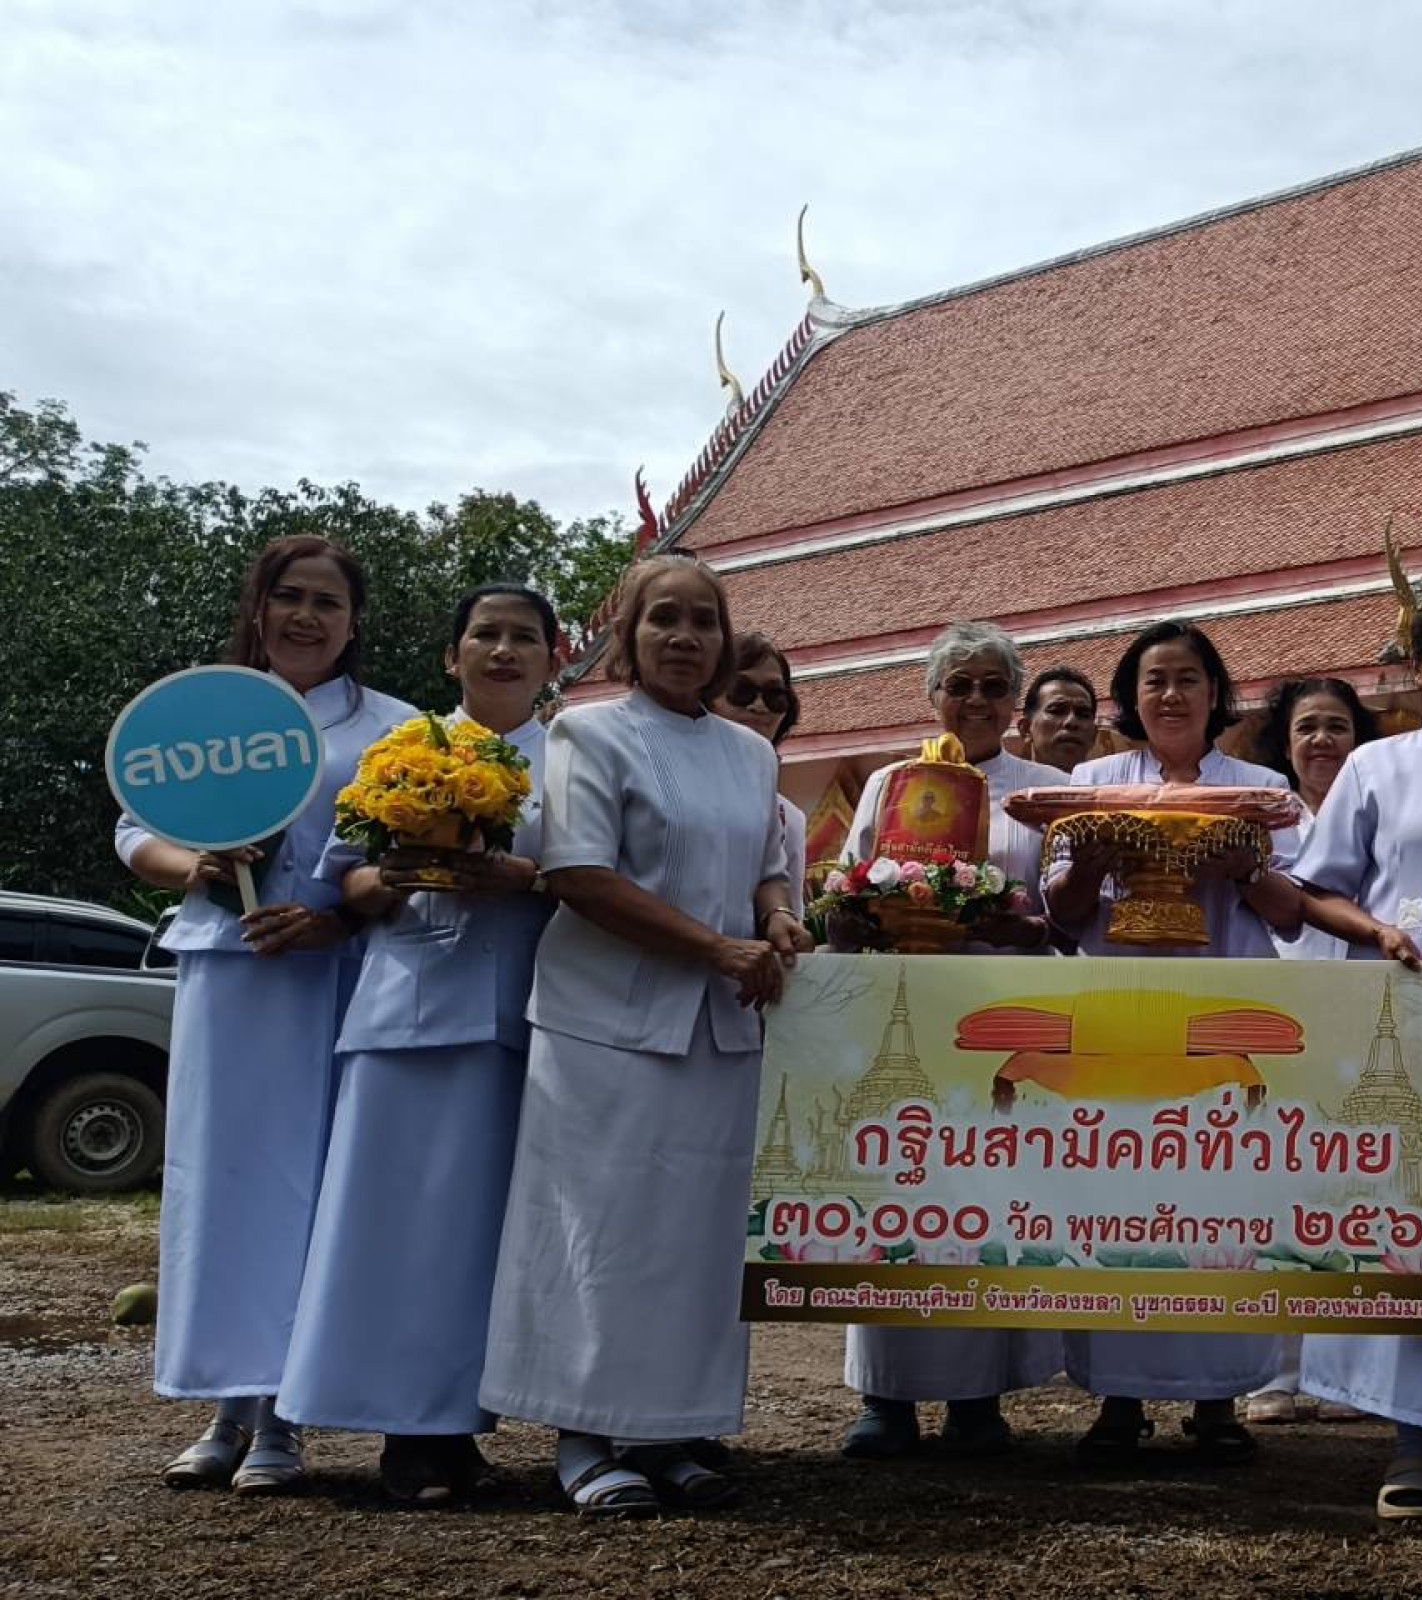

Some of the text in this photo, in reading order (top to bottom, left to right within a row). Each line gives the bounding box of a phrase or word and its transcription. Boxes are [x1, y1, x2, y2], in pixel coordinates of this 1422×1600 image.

[123, 729, 311, 786] สงขลา
[855, 1091, 1392, 1185] กฐินสามัคคีทั่วไทย
[772, 1201, 989, 1246] ๓๐,๐๐๐
[1007, 1200, 1052, 1241] วัด
[1066, 1203, 1273, 1256] พุทธศักราช
[765, 1279, 804, 1306] โดย
[811, 1279, 976, 1317] คณะศิษยานุศิษย์
[984, 1285, 1122, 1313] จังหวัดสงขลา
[1130, 1291, 1226, 1322] บูชาธรรม
